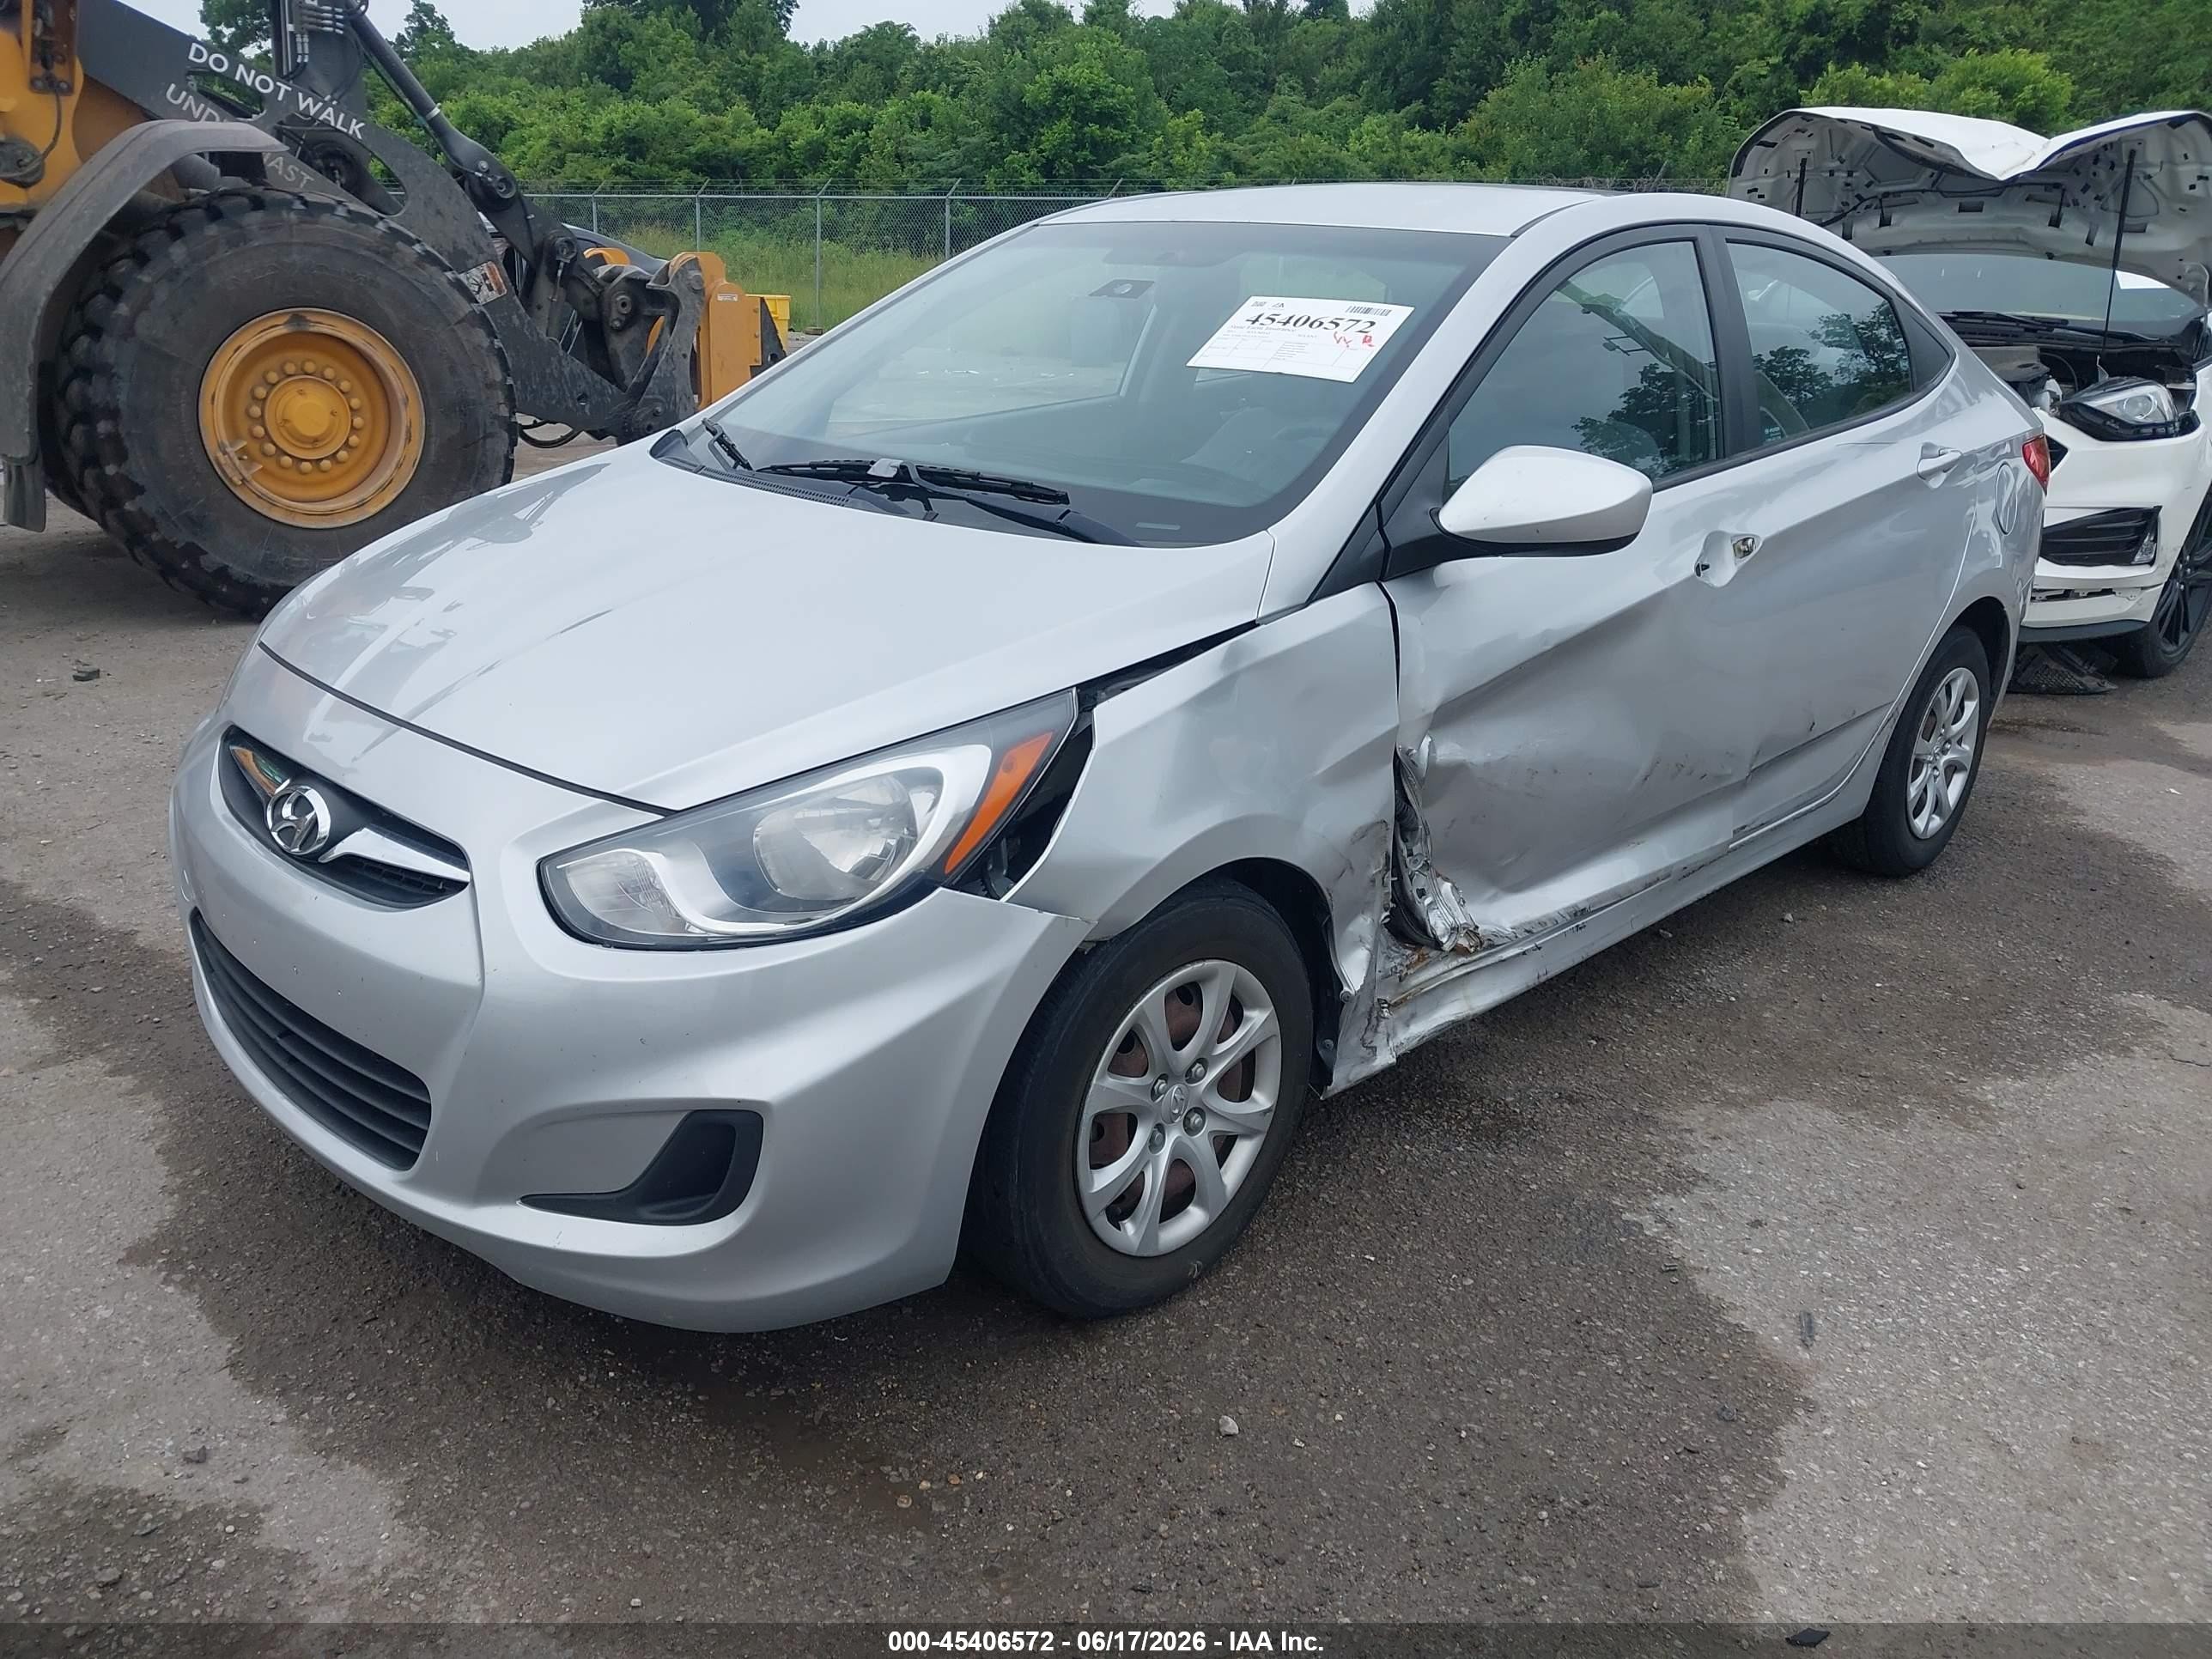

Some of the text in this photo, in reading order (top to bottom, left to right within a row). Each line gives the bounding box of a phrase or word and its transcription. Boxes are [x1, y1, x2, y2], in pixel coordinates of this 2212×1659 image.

[165, 83, 228, 123] UND
[188, 43, 366, 140] DO NOT WALK
[1245, 313, 1376, 333] 45406572
